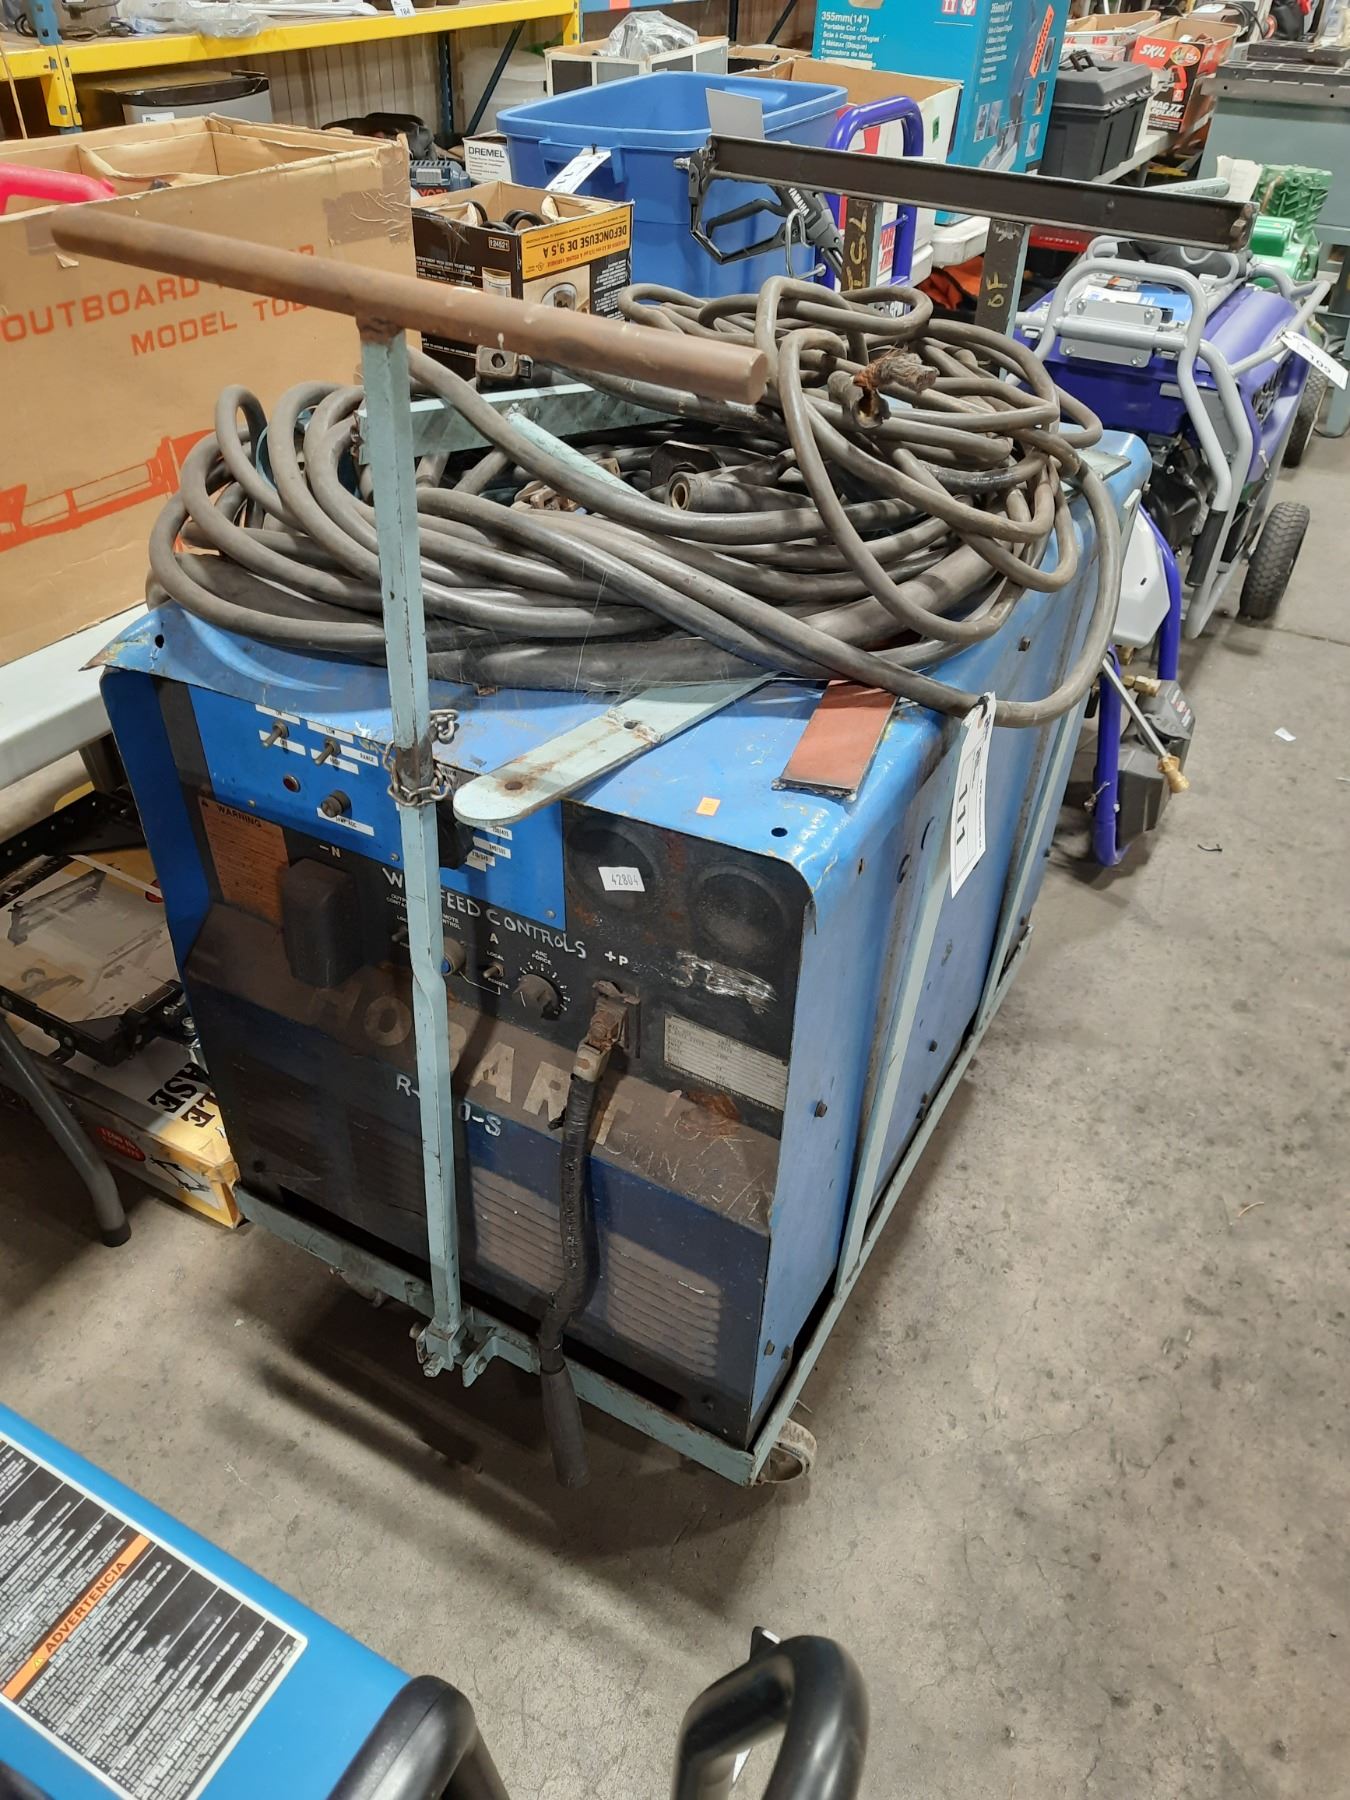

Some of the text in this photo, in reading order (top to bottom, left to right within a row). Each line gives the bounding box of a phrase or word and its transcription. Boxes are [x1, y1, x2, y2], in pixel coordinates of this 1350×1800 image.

[1139, 44, 1167, 59] SKIL
[468, 146, 505, 159] DREMEL
[788, 187, 810, 217] YAMAHA
[542, 247, 549, 259] A
[567, 240, 578, 251] DE
[1, 276, 200, 343] OUTBOARD
[130, 310, 238, 356] MODEL
[216, 803, 262, 828] WARNING
[611, 872, 639, 887] 42804
[486, 908, 587, 960] CONTROLS
[489, 932, 499, 945] A
[45, 1560, 128, 1654] ADVERTENCIA
